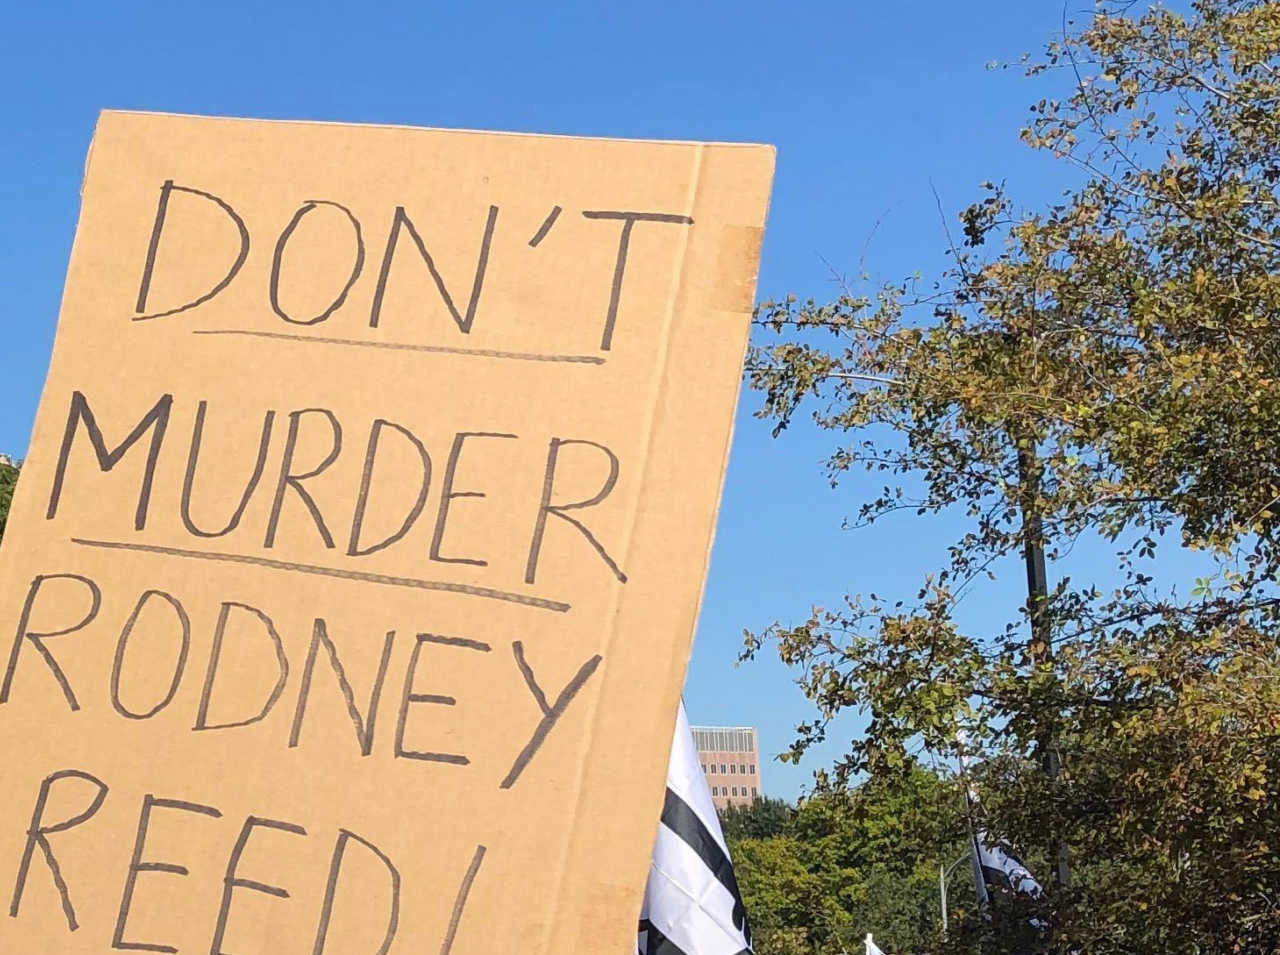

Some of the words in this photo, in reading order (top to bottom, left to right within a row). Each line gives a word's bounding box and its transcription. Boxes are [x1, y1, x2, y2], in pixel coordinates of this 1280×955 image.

[132, 178, 694, 352] DON'T
[46, 390, 627, 585] MURDER
[0, 573, 602, 789] RODNEY
